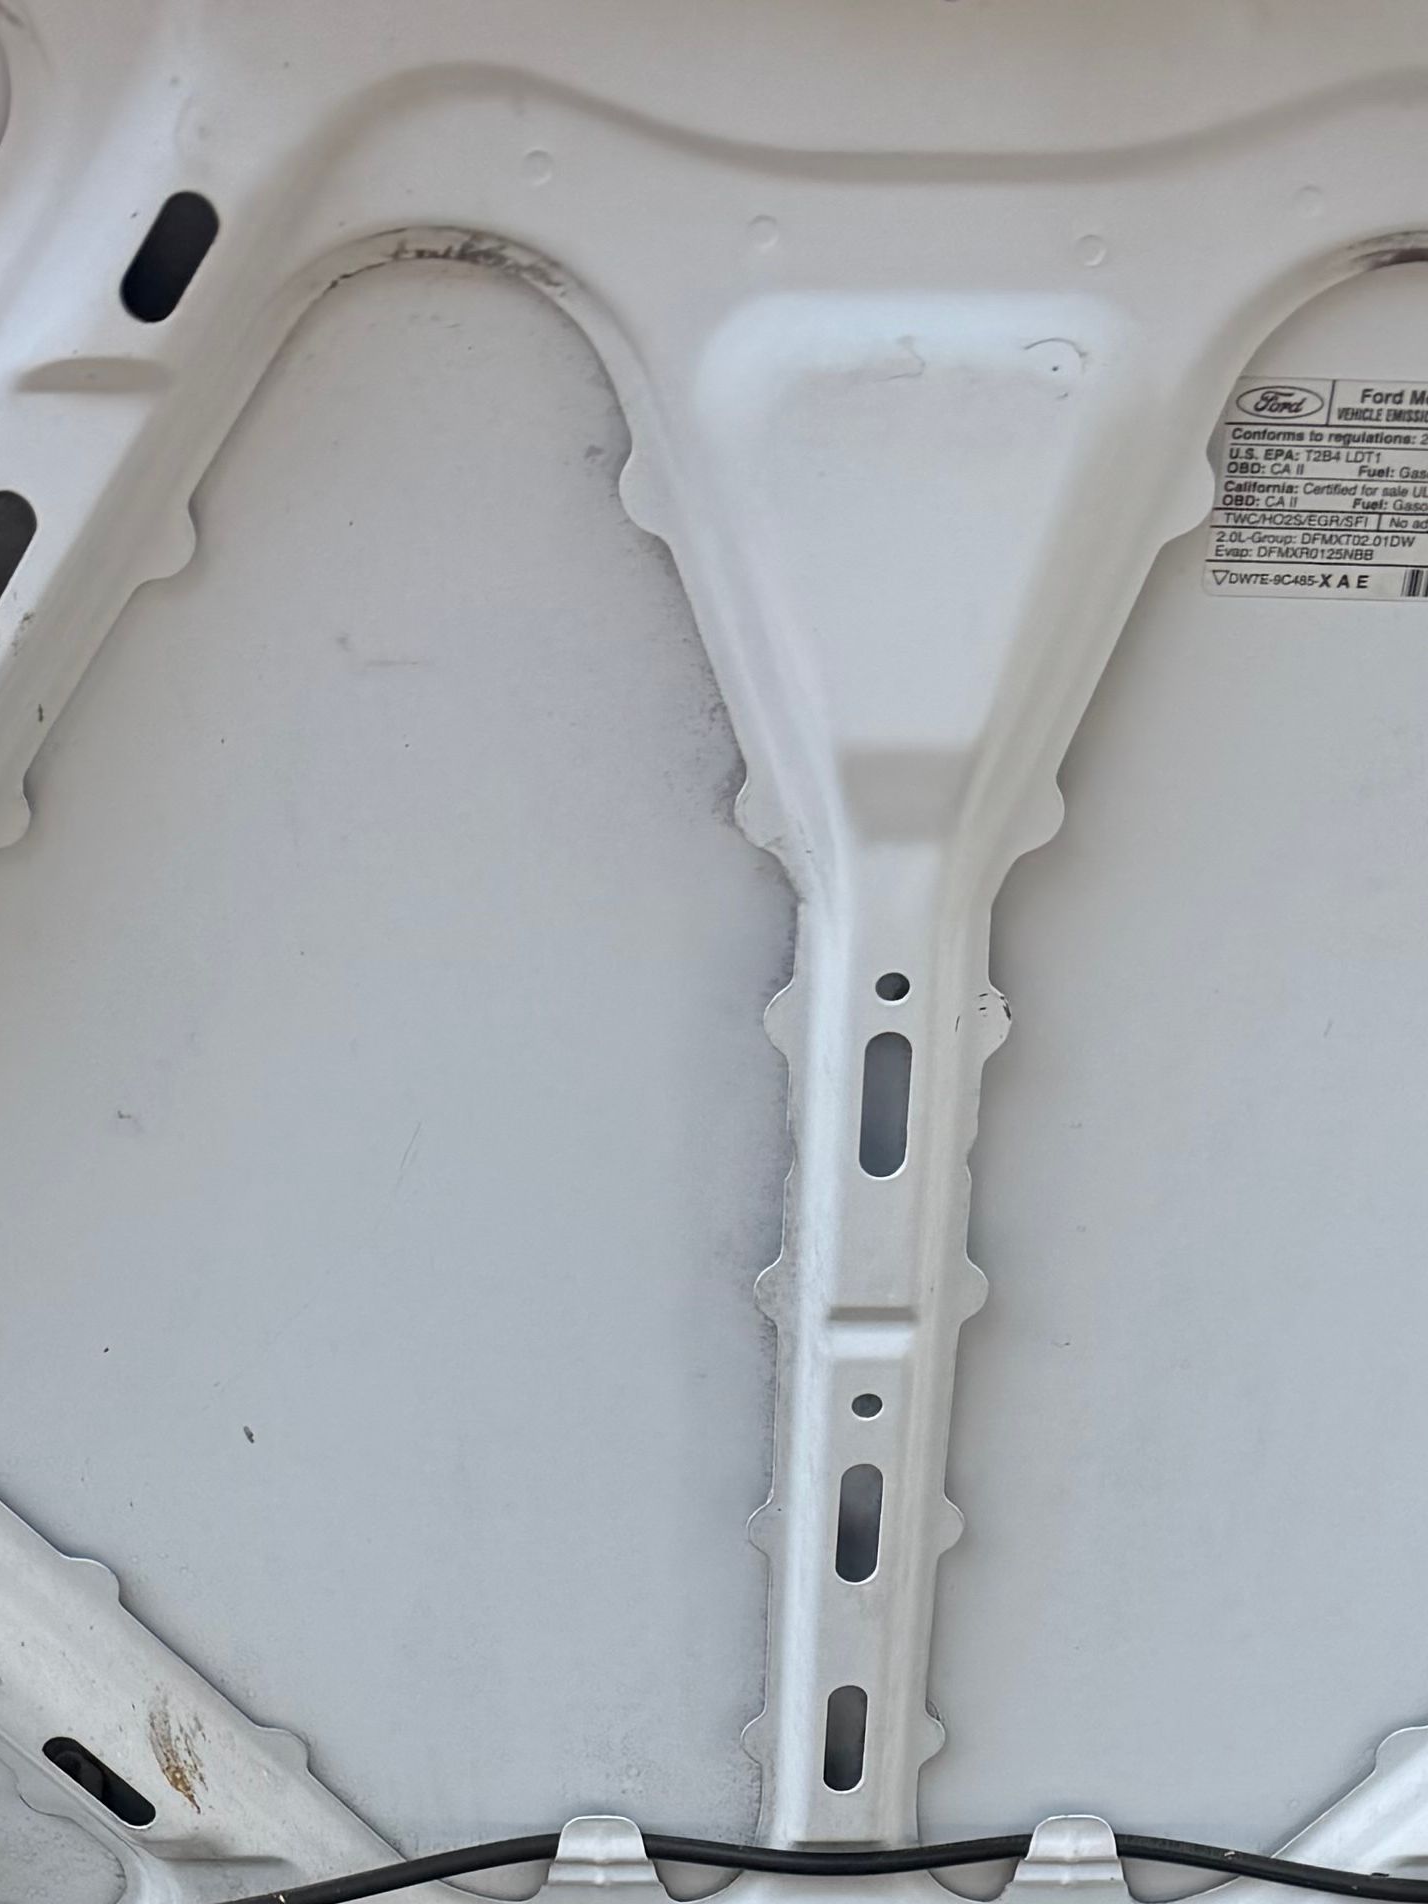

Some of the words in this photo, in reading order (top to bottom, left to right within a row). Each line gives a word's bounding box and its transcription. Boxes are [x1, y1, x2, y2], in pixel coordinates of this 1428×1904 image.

[1254, 390, 1307, 414] Ford
[1360, 388, 1404, 405] Ford
[1337, 407, 1383, 422] VEHICLE
[1231, 427, 1304, 441] Conforms
[1309, 429, 1324, 442] to
[1327, 431, 1417, 446] regulations:
[1229, 447, 1259, 461] U.S.
[1263, 448, 1300, 462] EPA:
[1305, 449, 1341, 463] T2B4
[1345, 450, 1382, 464] LDT1
[1227, 461, 1266, 474] OBD:
[1270, 462, 1291, 475] CA
[1295, 463, 1305, 475] II
[1358, 465, 1395, 478] Fuel:
[1224, 480, 1299, 494] California:
[1303, 482, 1360, 496] Certified
[1360, 484, 1379, 497] for
[1381, 485, 1408, 498] sale
[1222, 494, 1260, 507] OBD:
[1264, 495, 1285, 507] CA
[1351, 497, 1388, 510] Fuel:
[1223, 512, 1368, 528] TWC/HO2S/EGR/SFI
[1389, 517, 1408, 529] No
[1215, 531, 1298, 546] 2.0L-Group:
[1214, 545, 1254, 559] Evap:
